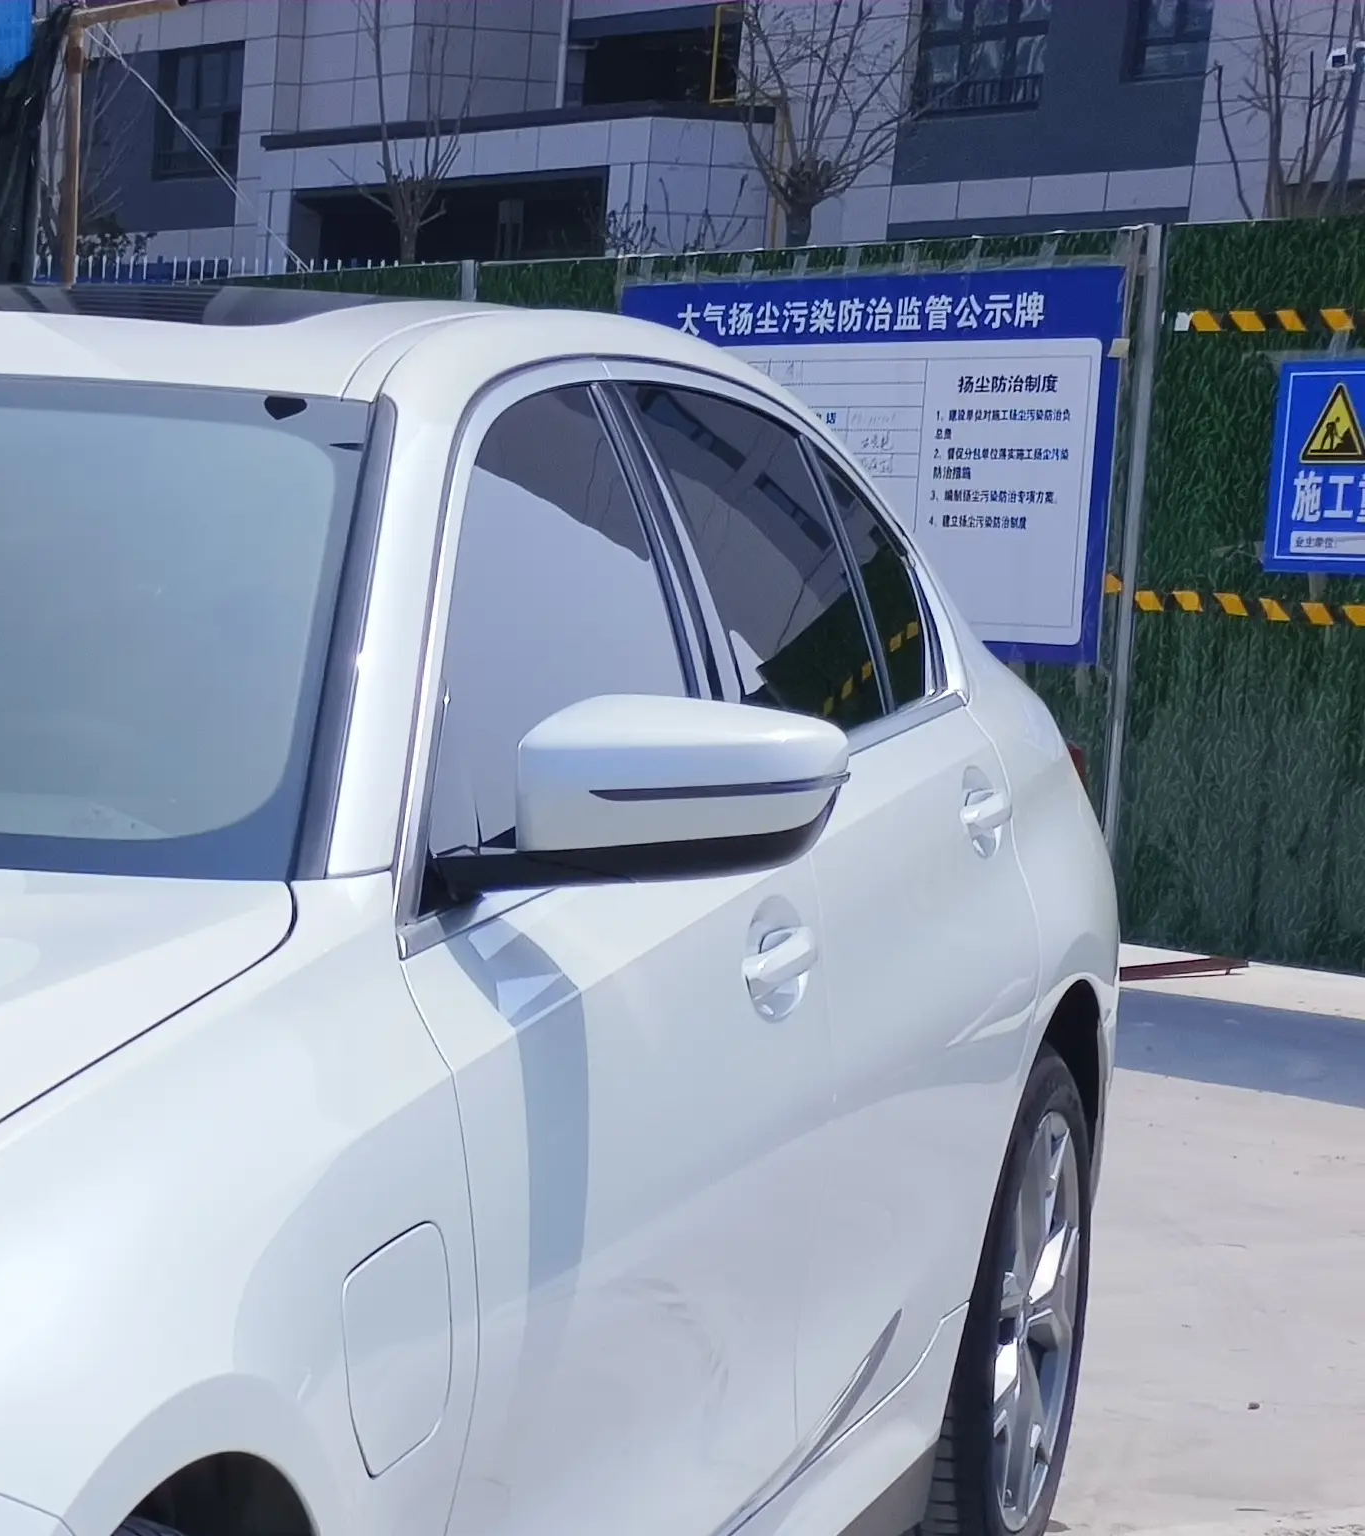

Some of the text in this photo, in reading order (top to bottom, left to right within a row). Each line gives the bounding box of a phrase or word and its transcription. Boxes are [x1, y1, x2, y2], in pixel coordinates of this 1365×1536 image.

[676, 290, 1045, 337] 大气扬尘污染防治监管公示牌
[957, 373, 1059, 394] 扬尘防治制度
